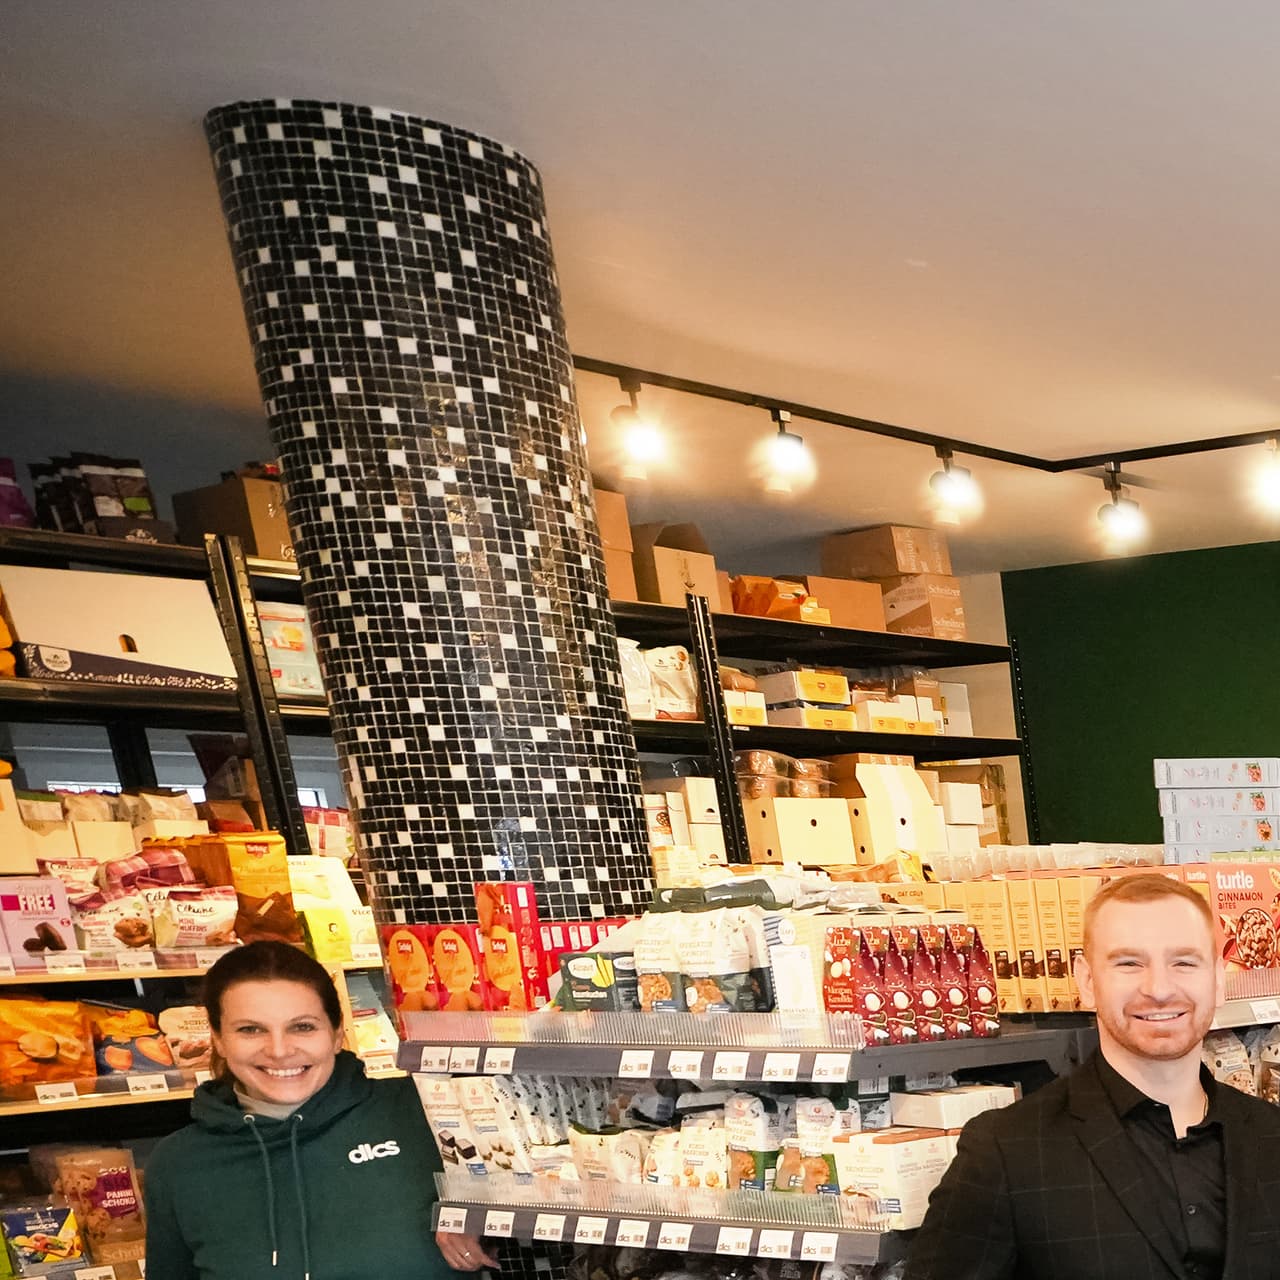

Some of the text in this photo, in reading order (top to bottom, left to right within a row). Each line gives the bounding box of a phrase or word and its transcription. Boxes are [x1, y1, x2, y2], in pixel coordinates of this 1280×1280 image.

[1216, 871, 1254, 889] turtle
[1218, 892, 1263, 902] CINNAMON
[349, 1141, 400, 1164] dlcs
[106, 1190, 133, 1198] PANINI
[102, 1198, 135, 1208] SCHOKO
